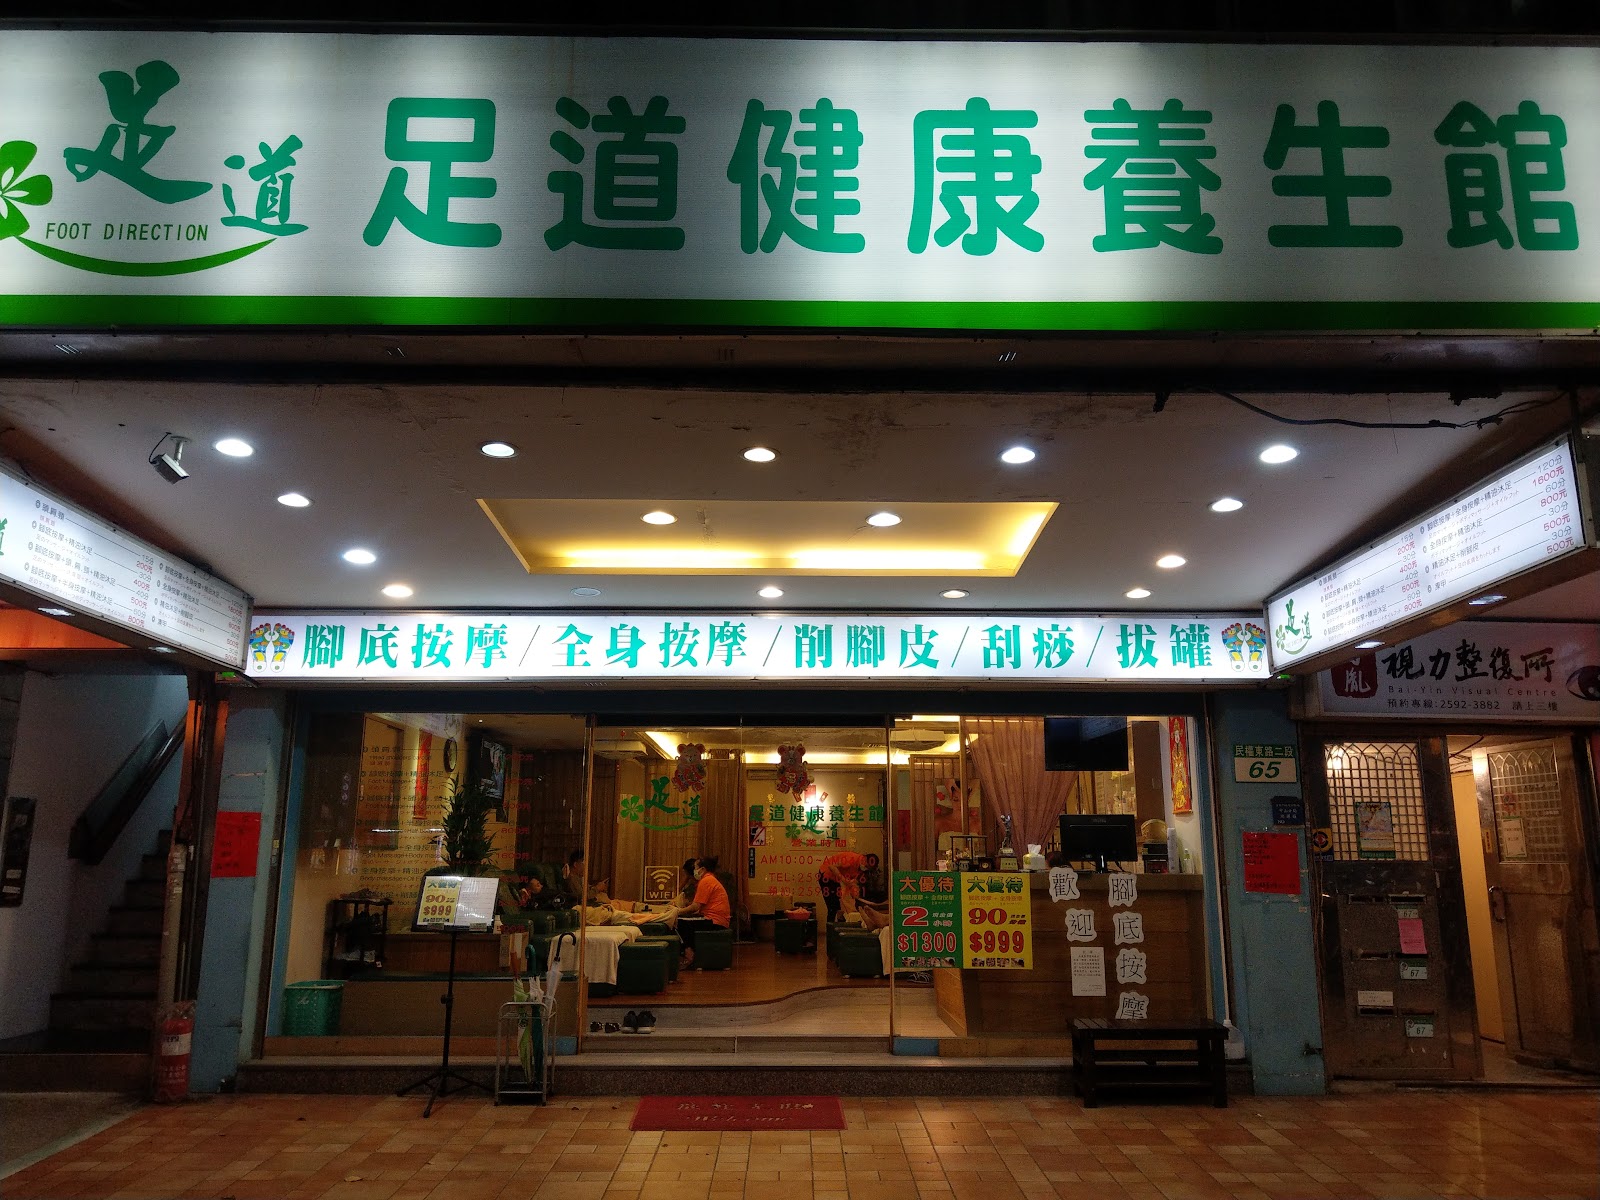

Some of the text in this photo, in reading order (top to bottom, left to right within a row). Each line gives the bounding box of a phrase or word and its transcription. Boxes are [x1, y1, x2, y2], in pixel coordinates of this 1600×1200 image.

[363, 96, 1580, 256] 足道健康養生館
[45, 223, 208, 242] FOOT DIRECTION
[1537, 453, 1562, 474] 120分
[1532, 463, 1564, 489] 1600元
[1545, 476, 1566, 495] 60分
[1540, 486, 1567, 509] 800元
[1548, 499, 1568, 517] 30分
[1543, 512, 1570, 533] 500元
[1400, 533, 1413, 544] 15分
[1551, 524, 1572, 541] 30分
[1396, 540, 1415, 556] 200元
[1546, 535, 1574, 555] 500元
[1402, 550, 1416, 563] 30分
[135, 559, 153, 574] 200元
[1398, 559, 1417, 574] 400元
[138, 570, 151, 582] 30分
[1404, 569, 1419, 582] 40分
[132, 577, 150, 592] 400元
[1400, 578, 1420, 594] 500元
[130, 595, 147, 610] 500元
[127, 614, 144, 627] 800元
[1285, 598, 1312, 640] 足道
[1382, 639, 1555, 683] 視力整復所
[1451, 686, 1499, 696] Visual
[1508, 688, 1558, 697] Centre
[1235, 745, 1294, 757] 民權東路二段
[1249, 761, 1281, 778] 65
[750, 804, 885, 822] 足道健康養生館
[899, 876, 955, 893] 大優待
[967, 876, 1023, 894] 大優待
[425, 894, 446, 903] 90
[422, 905, 452, 916] $999
[901, 906, 929, 927] 2
[968, 907, 1008, 926] 90
[897, 931, 957, 953] $1300
[969, 930, 1024, 954] $999
[1111, 878, 1147, 1019] 腳底按摩
[1410, 969, 1420, 978] 67
[1416, 1026, 1426, 1035] 67
